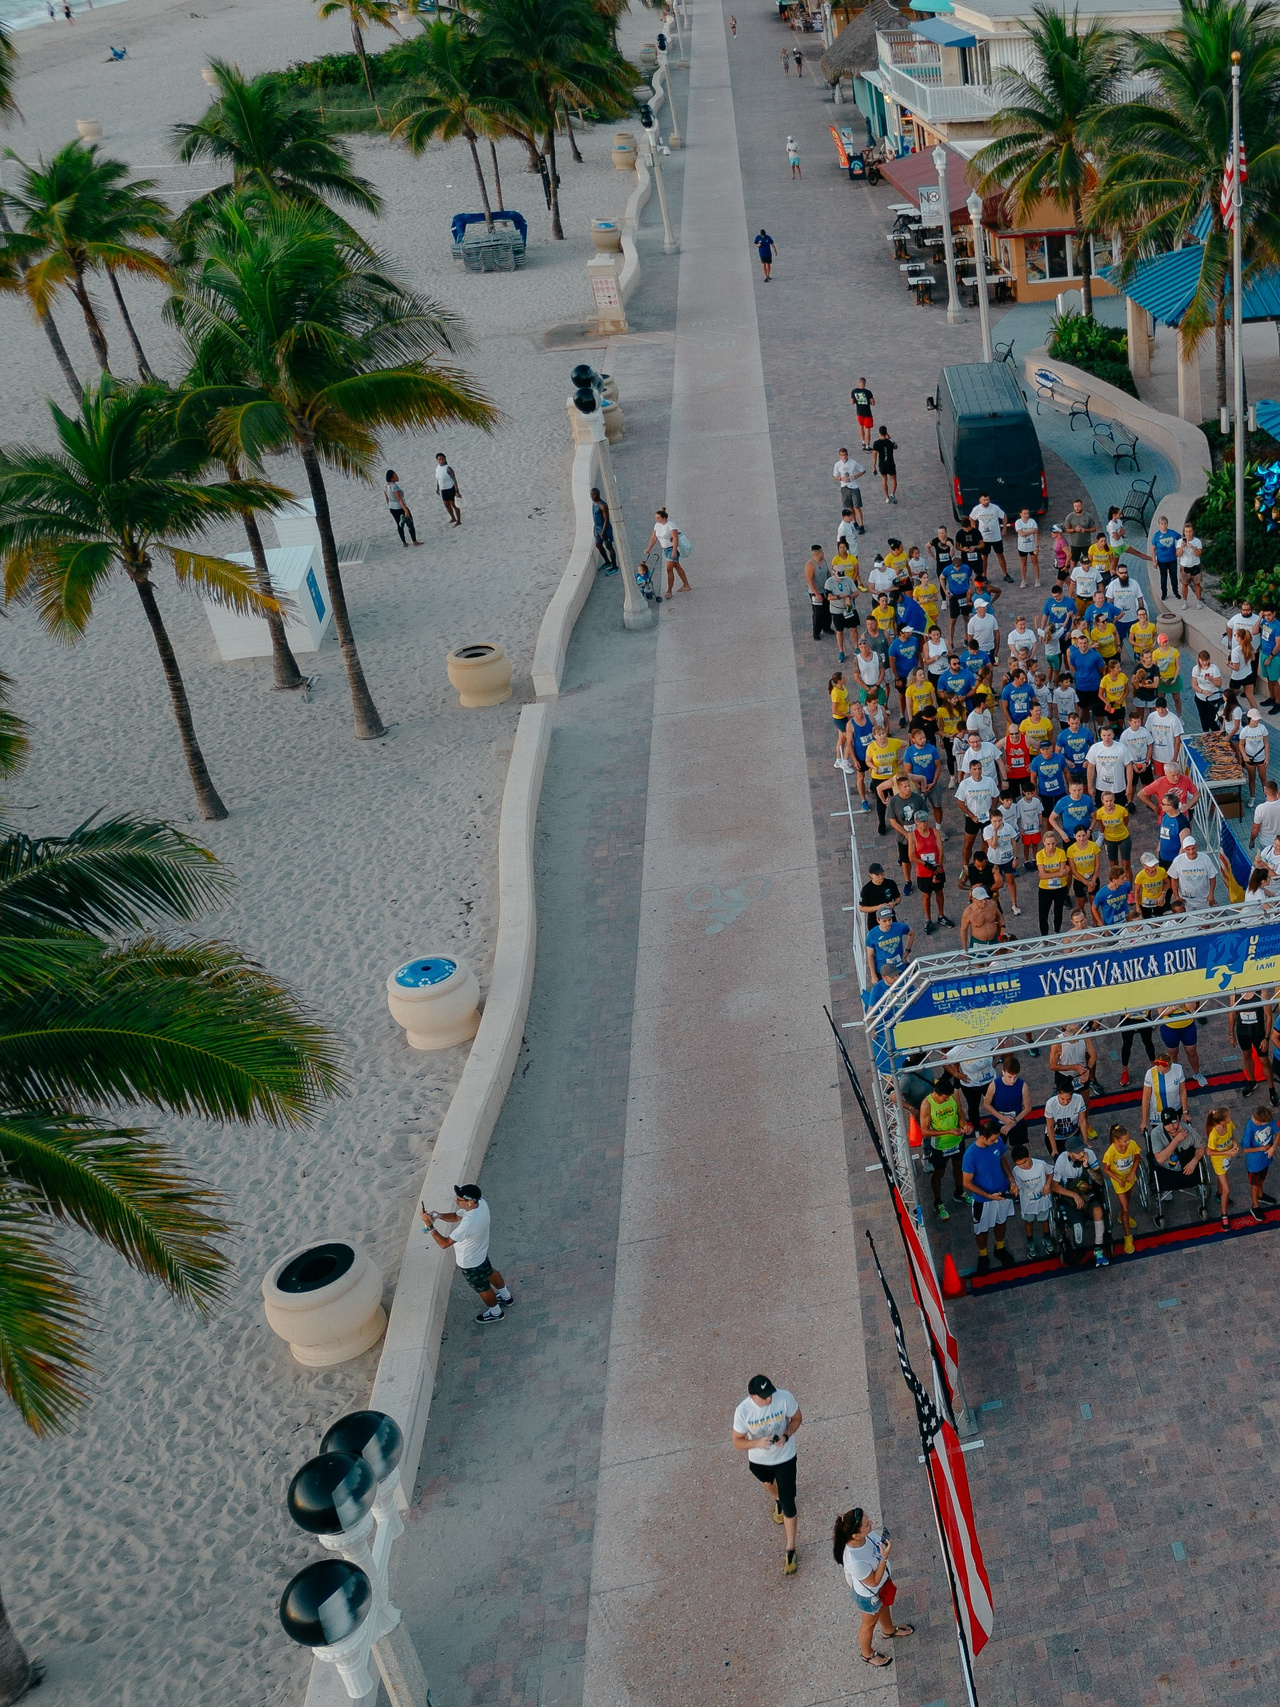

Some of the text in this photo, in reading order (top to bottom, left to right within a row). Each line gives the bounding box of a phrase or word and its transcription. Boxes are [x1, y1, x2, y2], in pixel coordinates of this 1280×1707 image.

[931, 973, 1021, 1001] UKRAINE
[1039, 947, 1197, 997] VYSHYVANKA RUN
